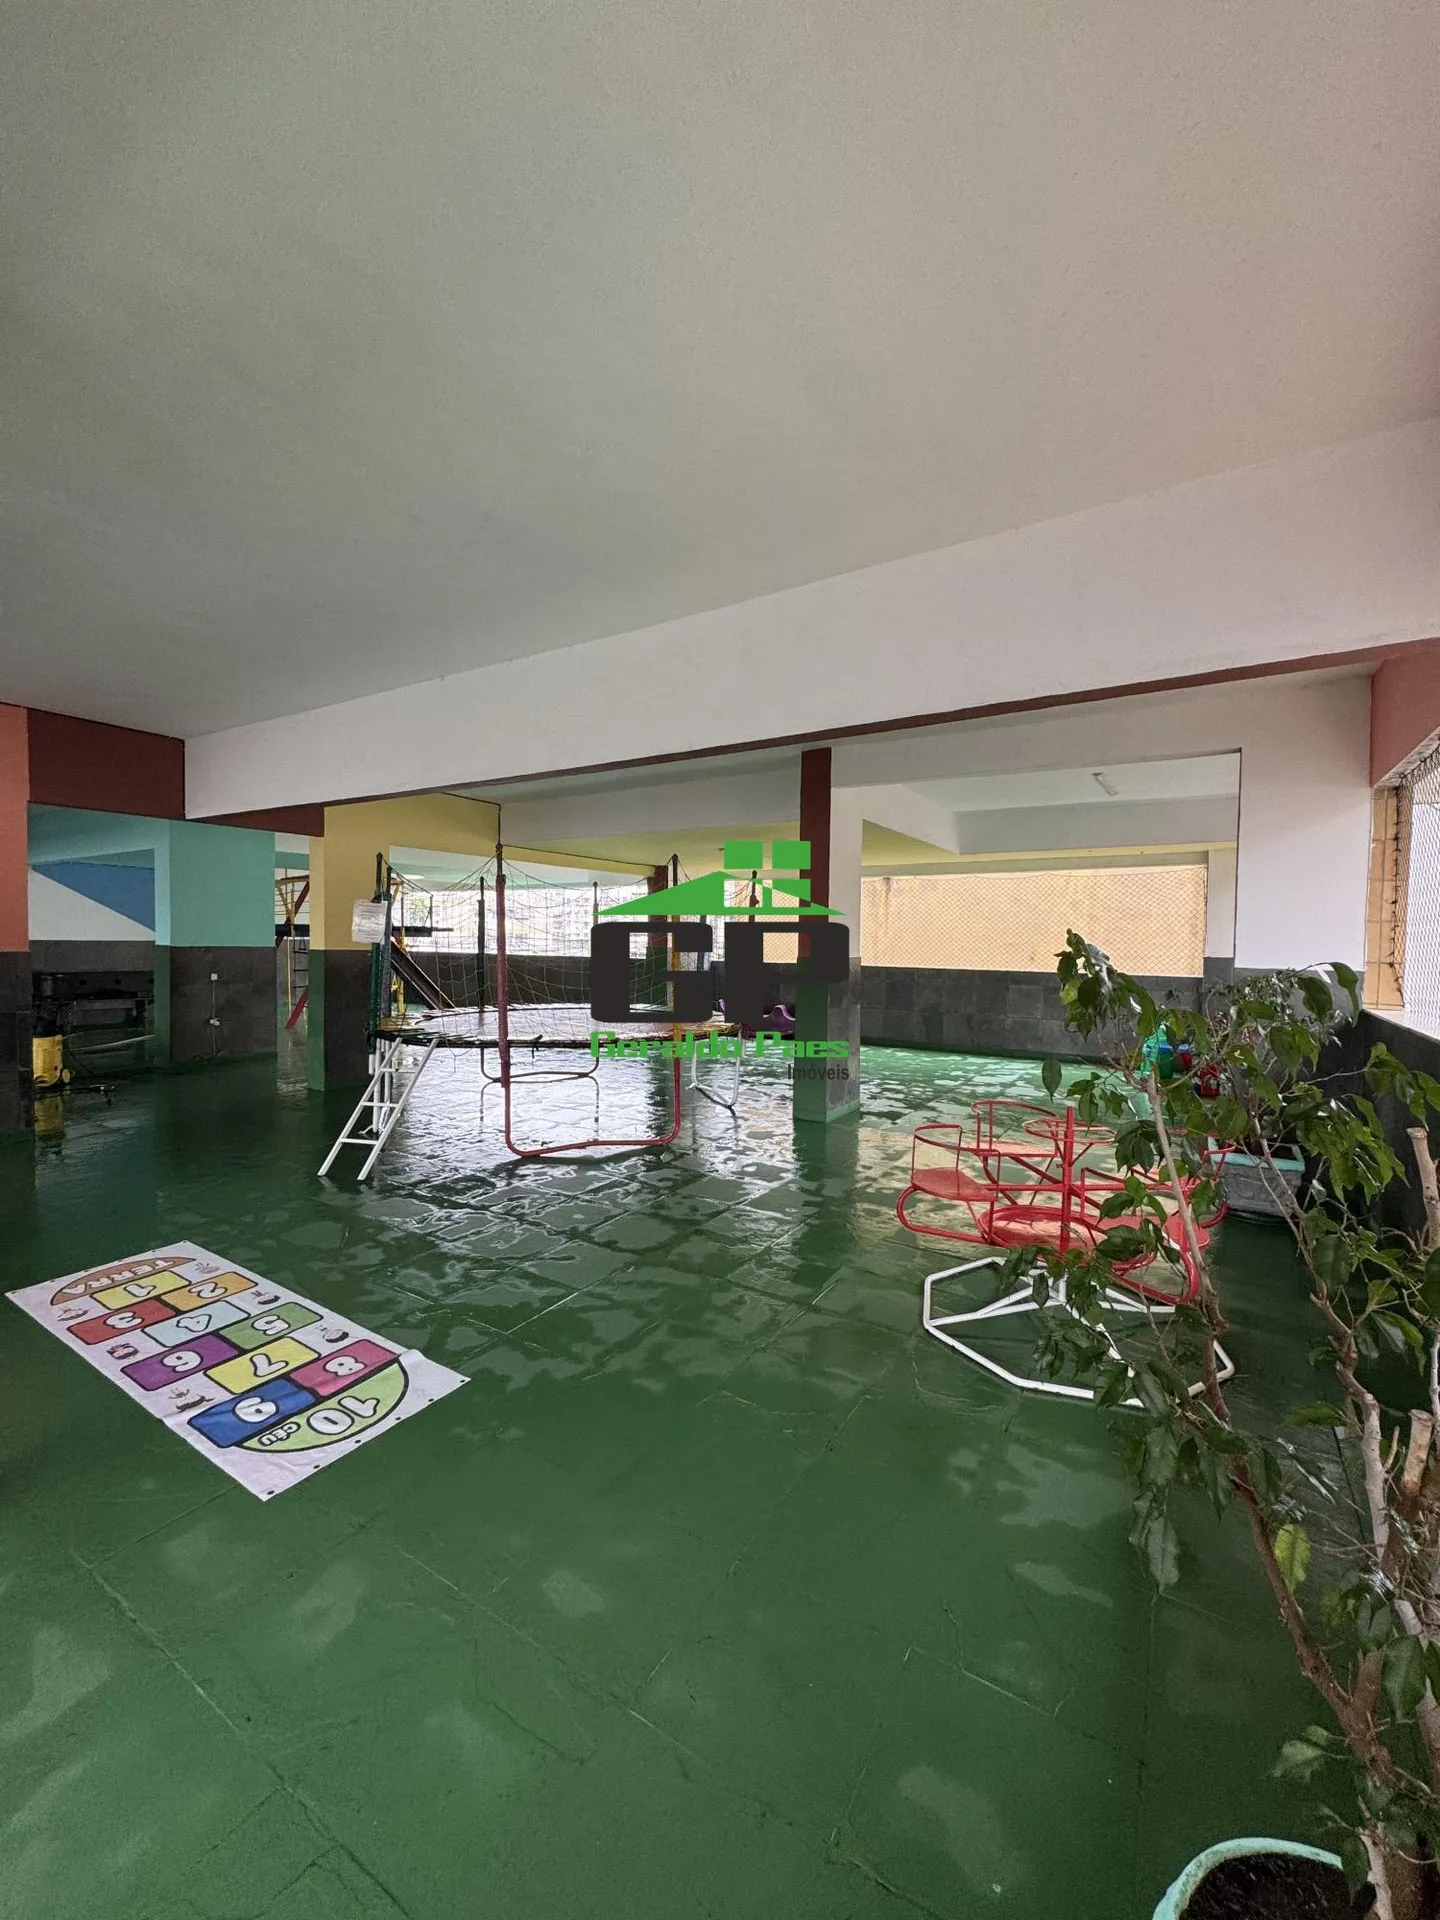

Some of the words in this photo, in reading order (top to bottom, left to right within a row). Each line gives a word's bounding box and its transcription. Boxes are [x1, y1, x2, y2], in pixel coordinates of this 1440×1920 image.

[61, 1258, 175, 1294] TERRA
[123, 1283, 156, 1297] 1
[188, 1281, 228, 1299] 2
[103, 1311, 145, 1329] 3
[175, 1314, 212, 1333] 4
[251, 1314, 291, 1336] 5
[161, 1350, 203, 1373] 6
[250, 1353, 289, 1377] 7
[323, 1355, 367, 1376] 8
[232, 1396, 279, 1424] 9
[306, 1396, 380, 1435] 10
[257, 1421, 301, 1446] CÉU
